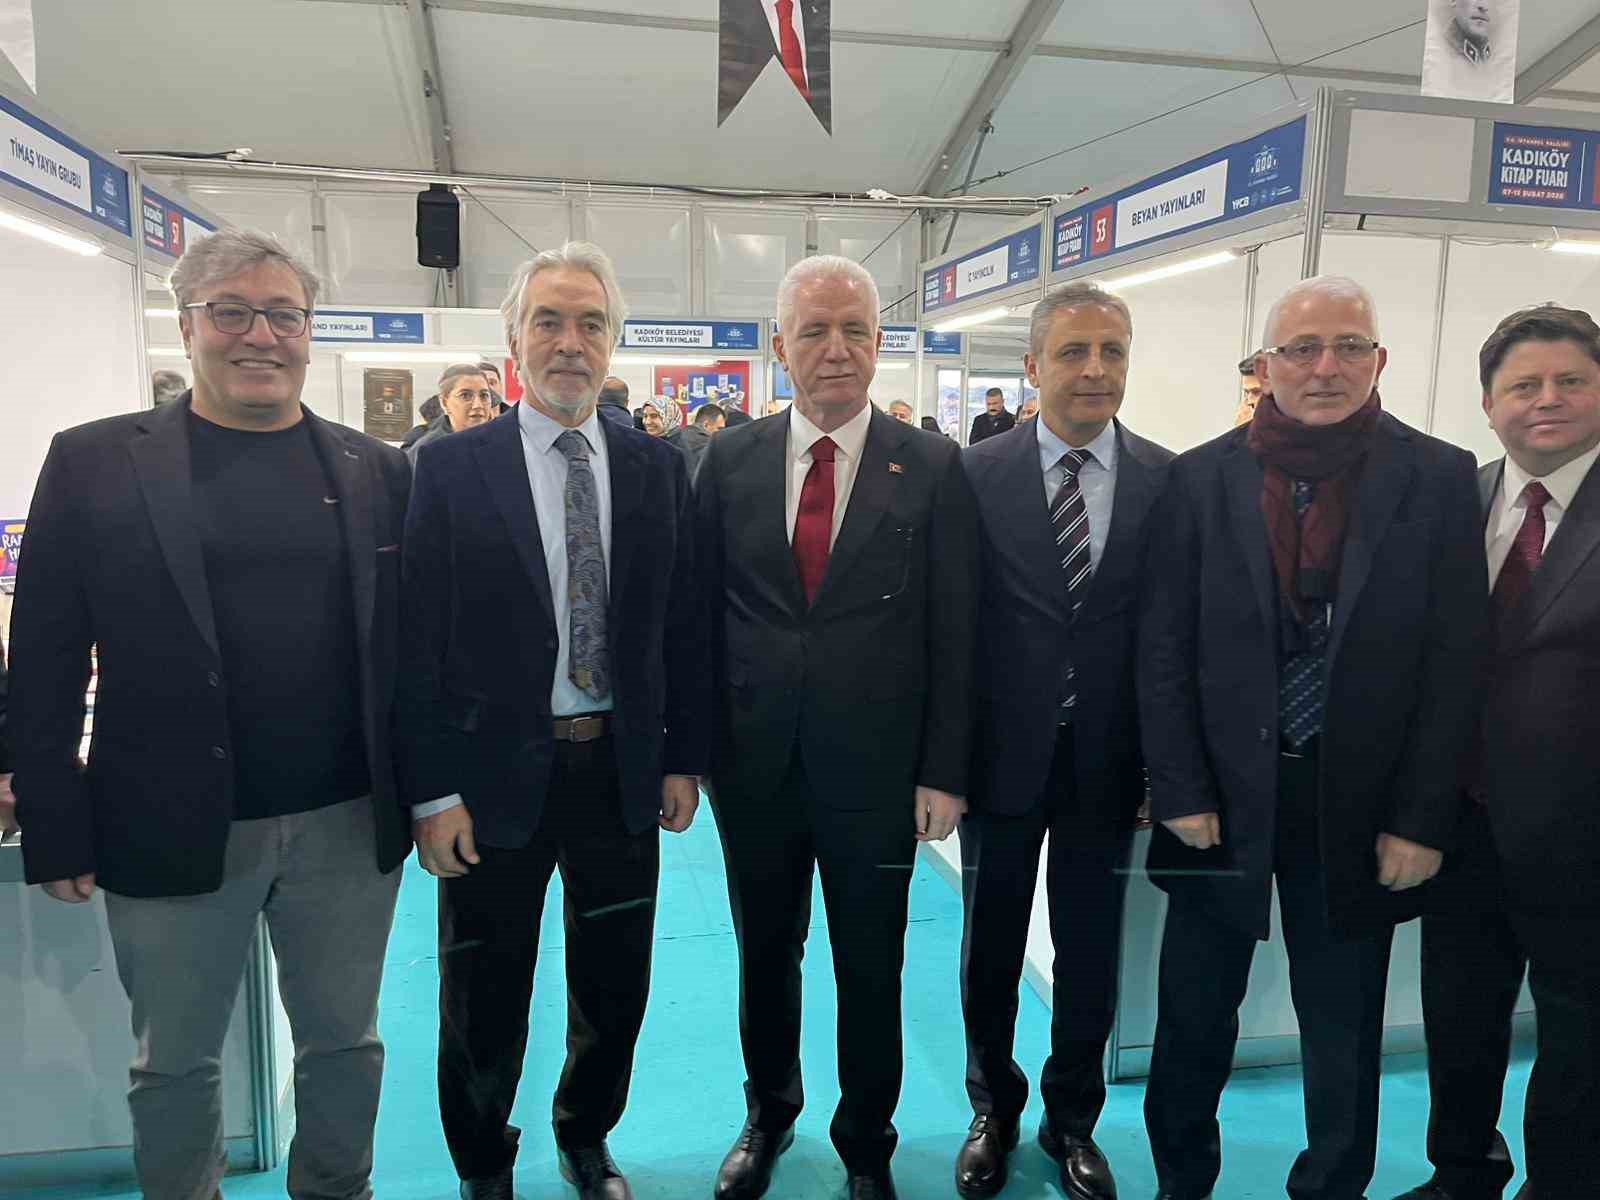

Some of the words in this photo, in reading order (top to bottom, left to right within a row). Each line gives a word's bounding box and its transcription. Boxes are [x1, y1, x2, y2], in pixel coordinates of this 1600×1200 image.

[10, 137, 34, 167] TİMAŞ
[35, 152, 57, 177] YAYIN
[58, 164, 81, 189] GRUBU
[1502, 146, 1570, 168] KADIKÖY
[1501, 166, 1533, 185] KİTAP
[1535, 169, 1568, 187] FUARI
[1131, 205, 1158, 226] BEYAN
[1159, 188, 1206, 217] YAYINLARI
[1058, 223, 1083, 243] KADIKÖY
[634, 328, 664, 336] KADIKÖY
[666, 329, 704, 337] BELEDİYESİ
[638, 335, 663, 343] KÜLTÜR
[666, 336, 700, 344] YAYINLARI
